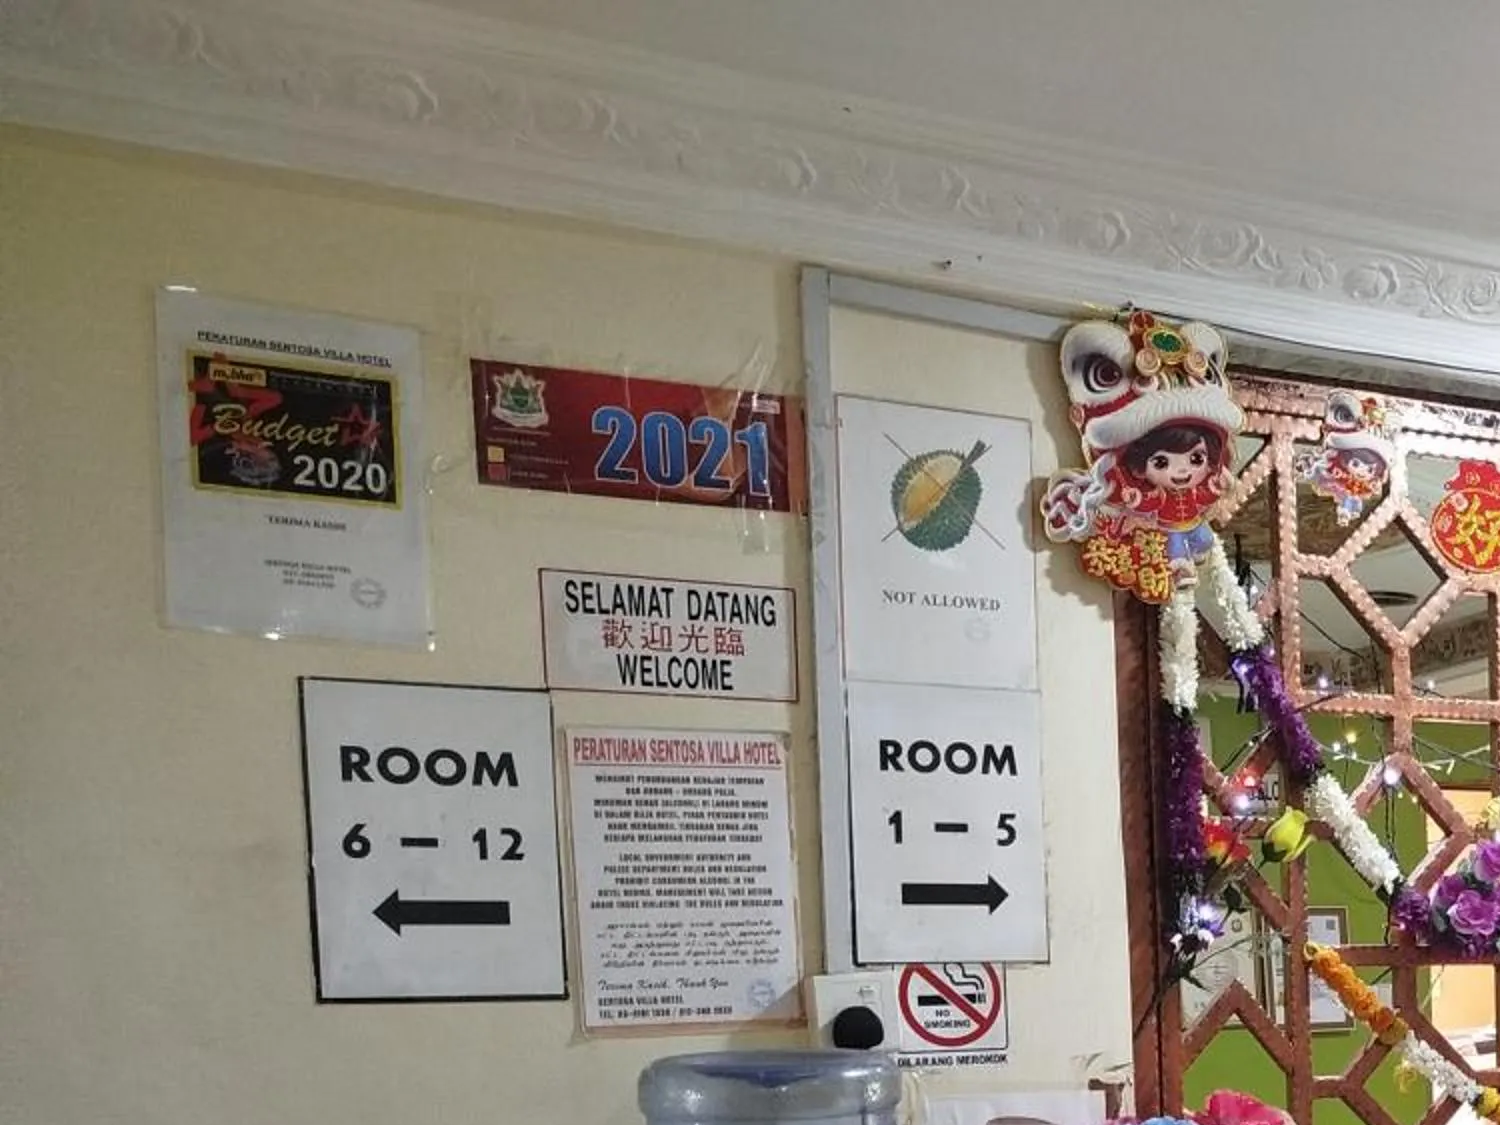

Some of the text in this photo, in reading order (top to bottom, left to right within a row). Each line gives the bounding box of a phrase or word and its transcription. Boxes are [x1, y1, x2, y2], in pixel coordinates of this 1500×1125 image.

[356, 352, 392, 368] HOTEL
[211, 403, 339, 450] Budget
[591, 405, 771, 498] 2021
[293, 454, 388, 494] 2020
[564, 579, 777, 627] SELAMAT DATANG
[881, 589, 1001, 612] NOT ALLOWED
[602, 618, 745, 657] 歡迎光臨
[616, 654, 734, 691] WELCOME
[340, 745, 519, 787] ROOM
[573, 736, 781, 765] PERATURAN SENTOSA VILLA HOTEL
[878, 739, 1019, 777] ROOM
[342, 822, 372, 859] 6
[472, 827, 525, 861] 12
[888, 810, 904, 844] 1
[996, 813, 1017, 846] 5
[923, 1019, 971, 1029] SMOKING
[935, 1009, 951, 1017] NO
[897, 1053, 1008, 1067] DILARANG MEROKOK
